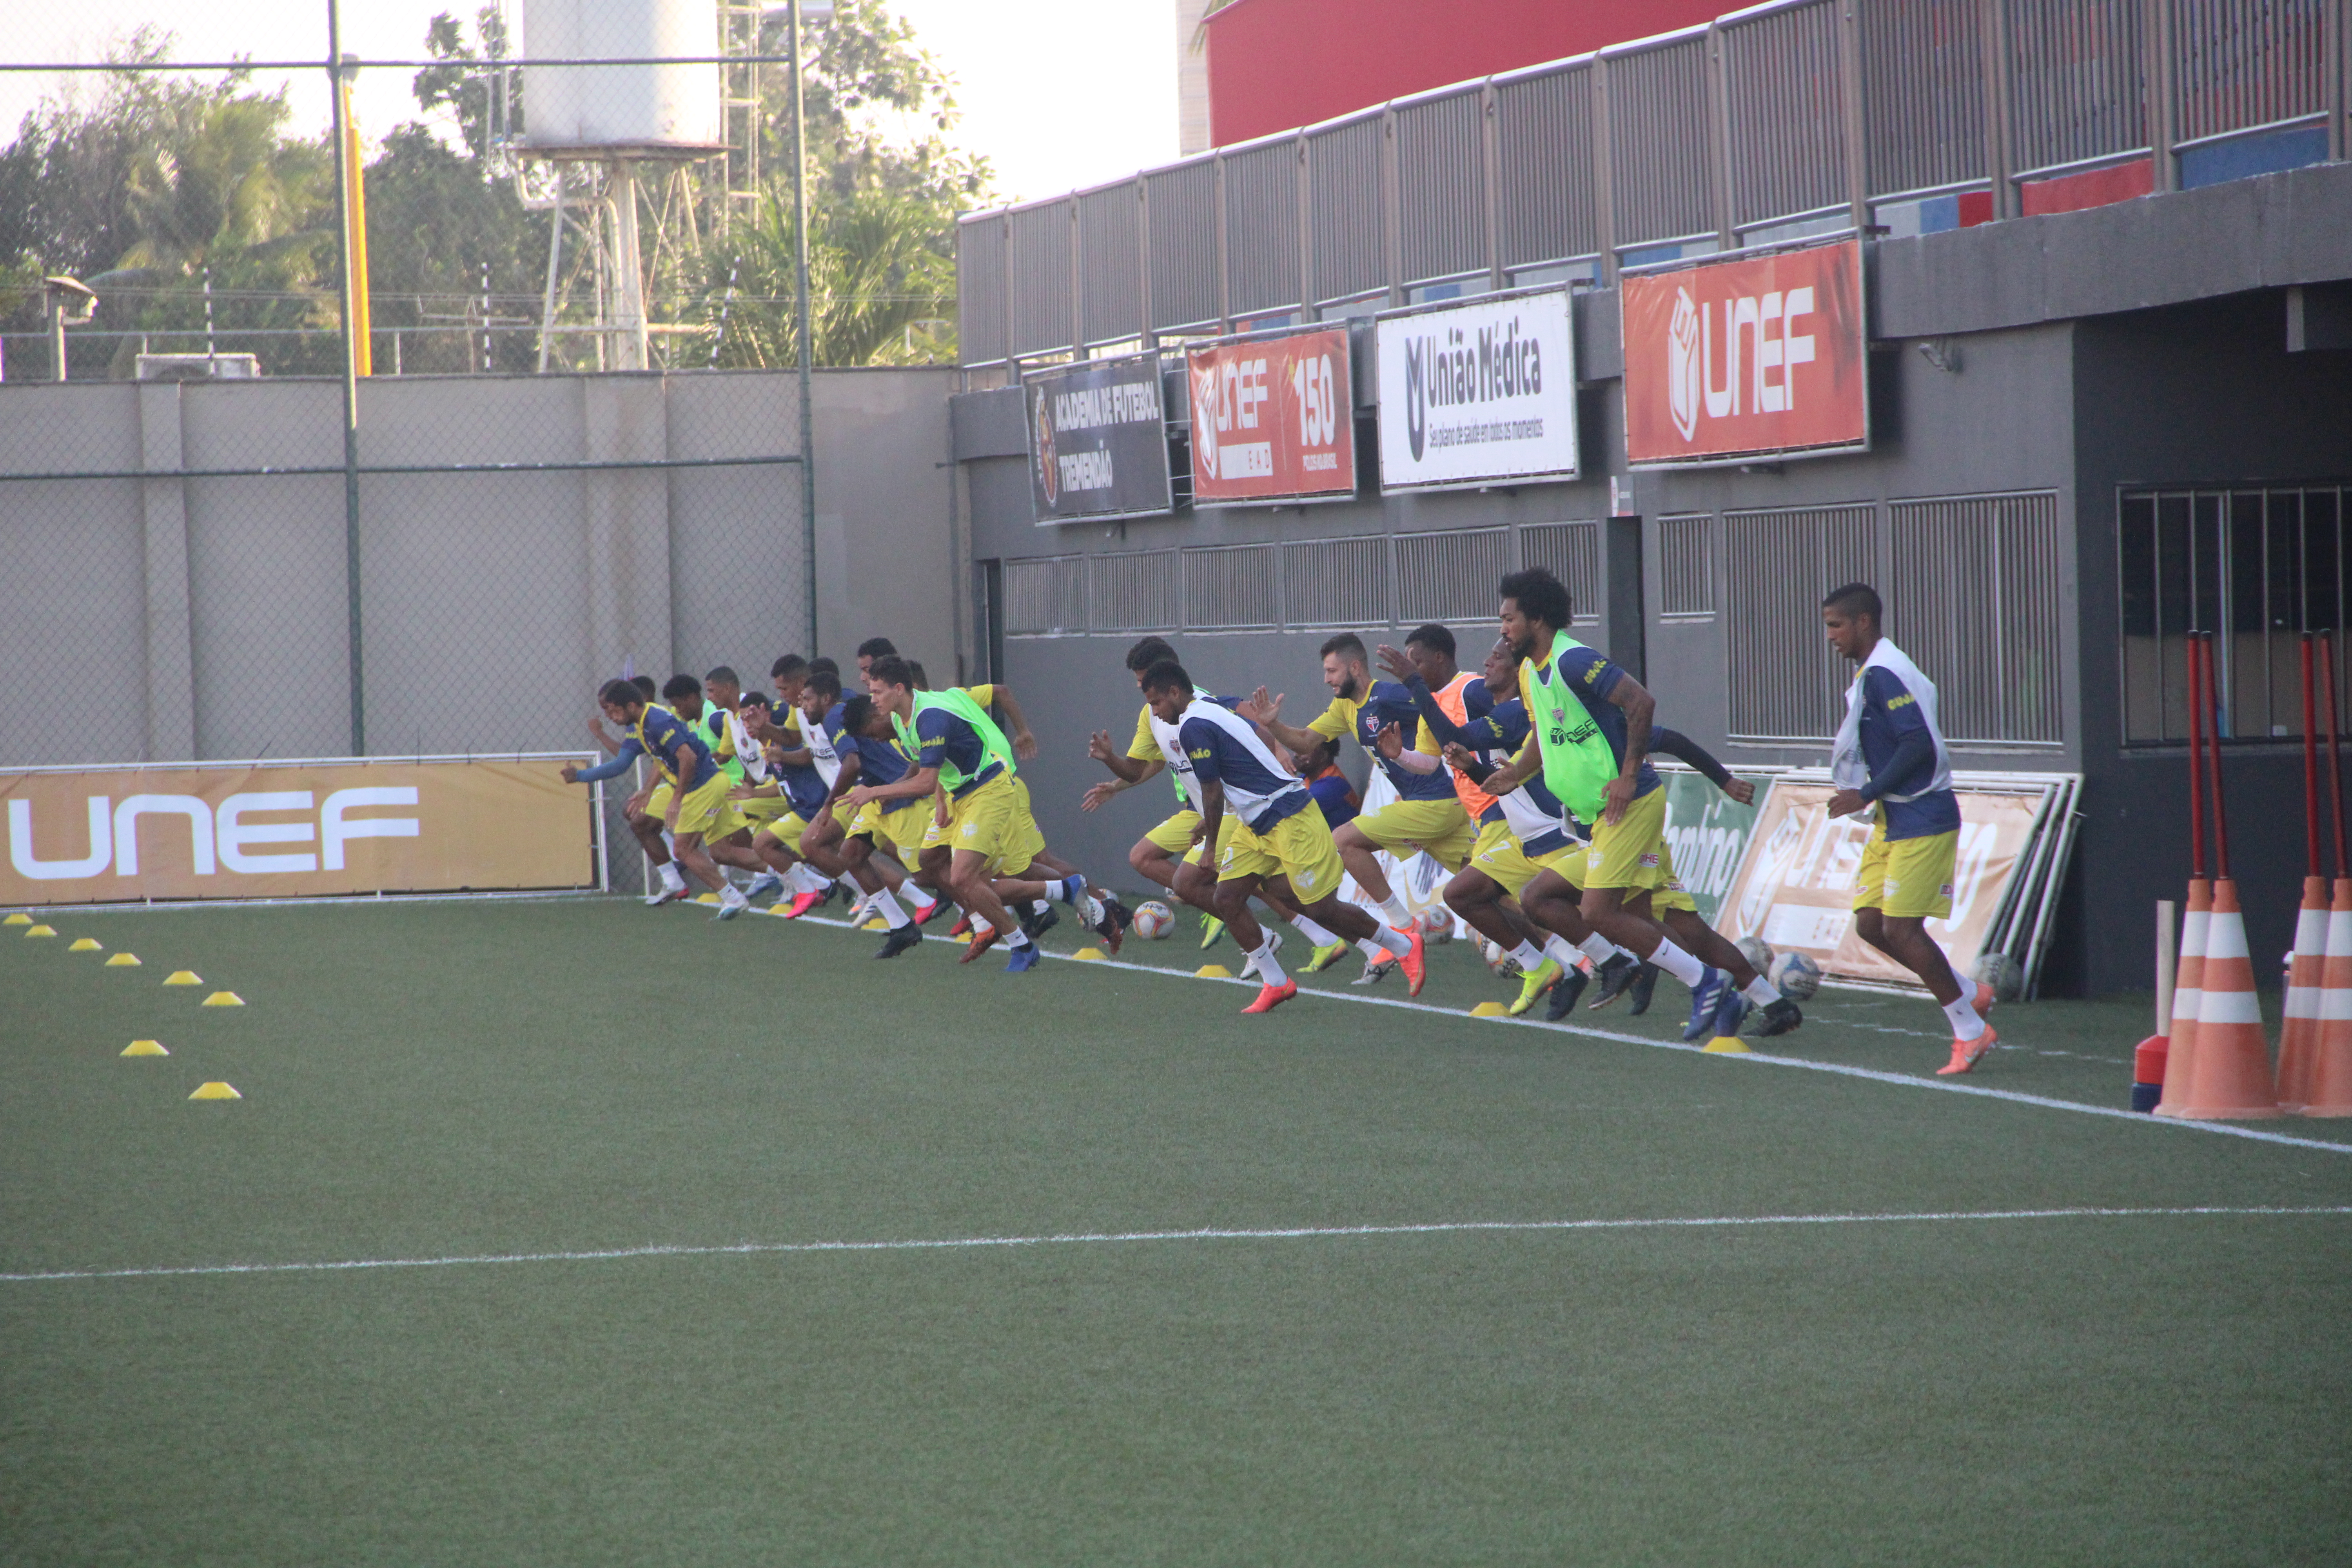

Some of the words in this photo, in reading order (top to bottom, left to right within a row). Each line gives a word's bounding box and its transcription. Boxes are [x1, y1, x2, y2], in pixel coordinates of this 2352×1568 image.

[1216, 358, 1268, 432] UNEF
[1427, 327, 1476, 408] União
[1479, 315, 1541, 403] Médica
[1702, 286, 1815, 418] UNEF
[1056, 389, 1102, 432] ACADEMIA
[1100, 387, 1114, 426] DE
[1112, 381, 1159, 424] FUTEBOL
[1294, 354, 1335, 446] 150
[1059, 438, 1113, 492] TREMENDÃO
[7, 786, 419, 880] UNEF
